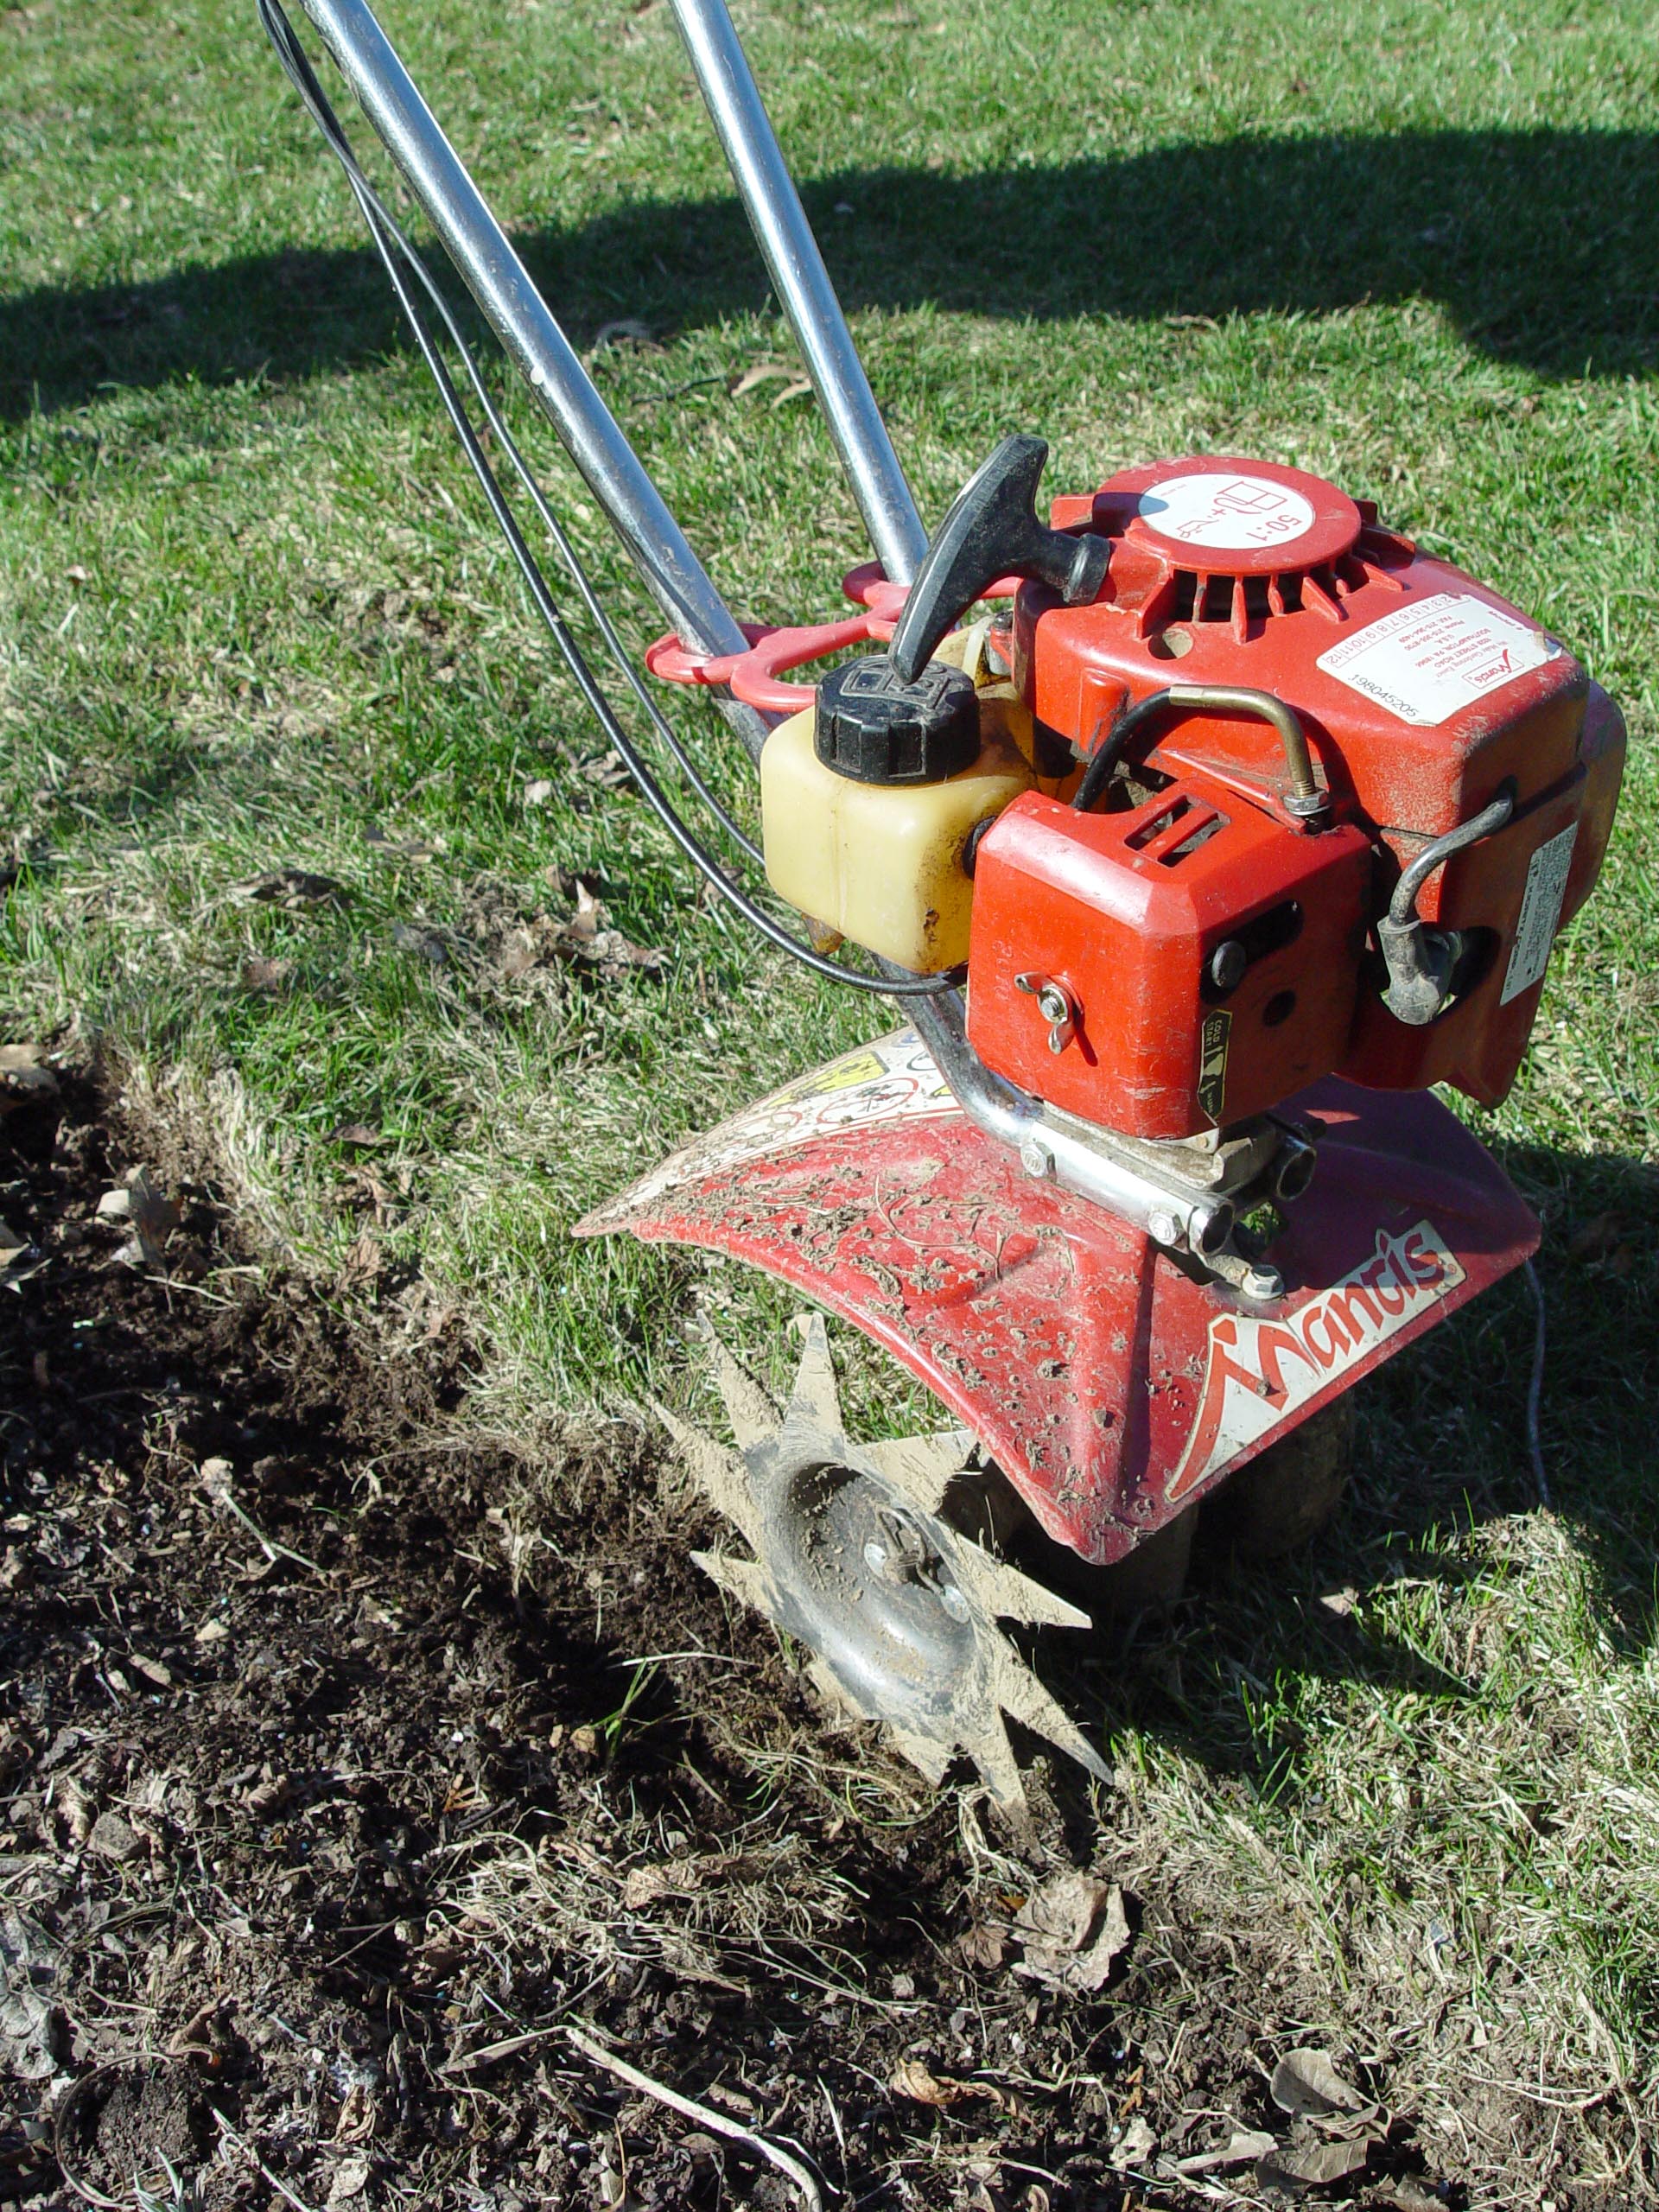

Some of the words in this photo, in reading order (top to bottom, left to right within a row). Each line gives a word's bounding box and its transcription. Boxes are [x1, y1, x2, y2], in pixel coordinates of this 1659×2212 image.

[1246, 515, 1302, 541] 50:1
[1365, 631, 1376, 639] 9
[1340, 645, 1354, 654] 11
[1351, 638, 1365, 648] 10
[1453, 643, 1478, 658] STREET
[1325, 654, 1342, 664] 12
[1434, 656, 1453, 668] ROAD
[1474, 648, 1512, 683] Mantis
[1348, 674, 1420, 717] 198045205
[1213, 1020, 1223, 1043] COLD
[1170, 1232, 1445, 1500] Mantis
